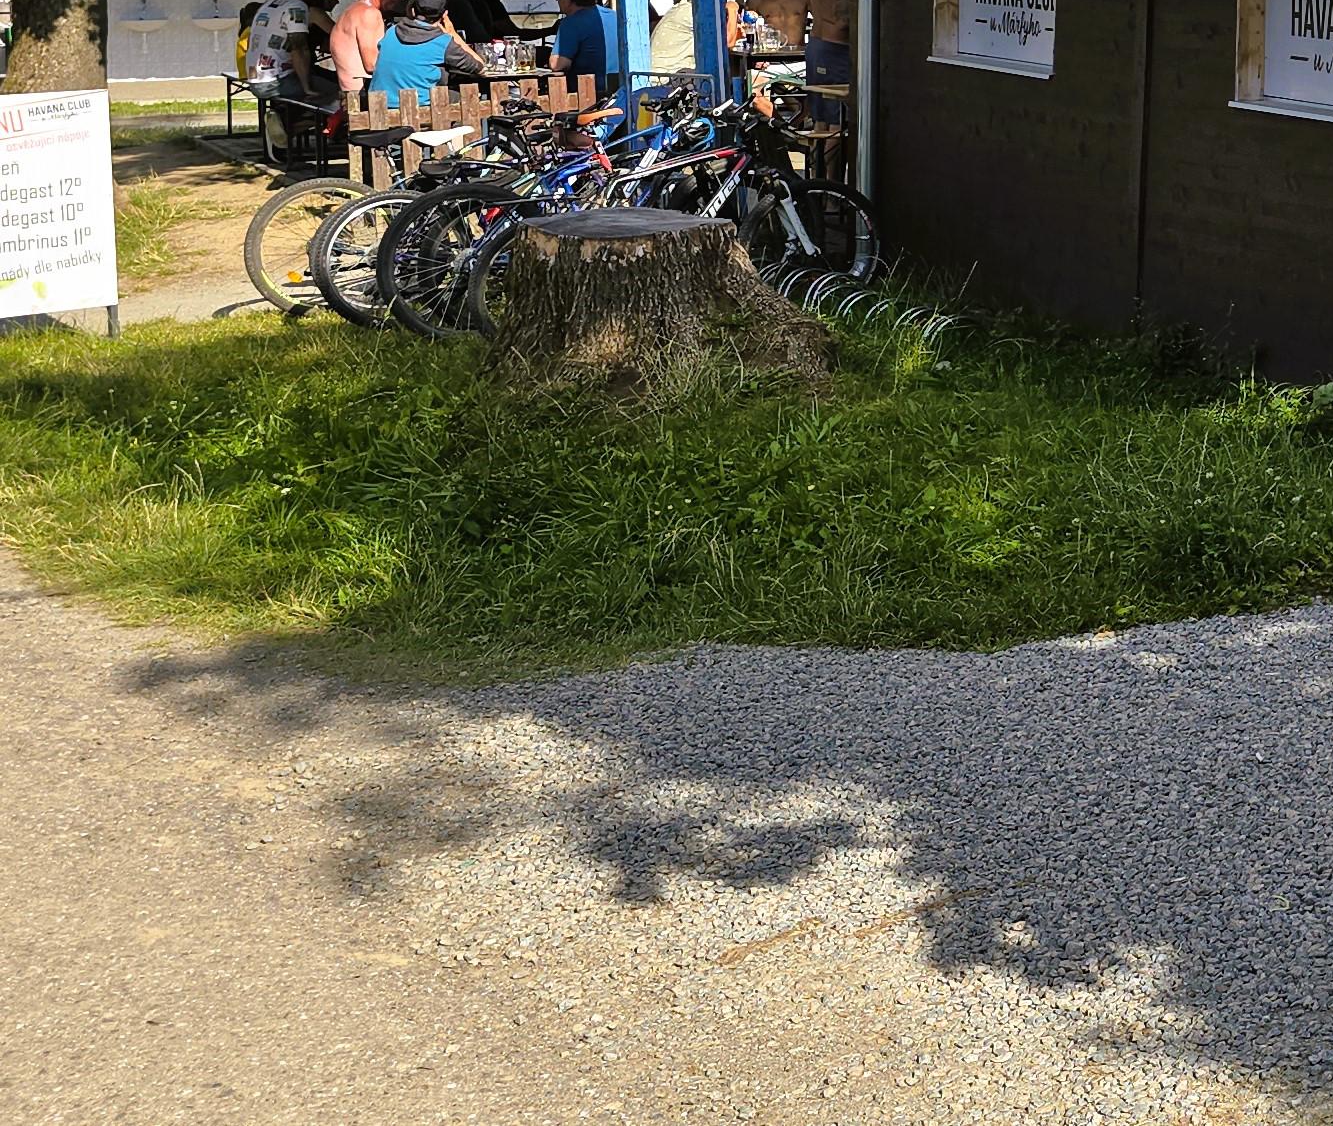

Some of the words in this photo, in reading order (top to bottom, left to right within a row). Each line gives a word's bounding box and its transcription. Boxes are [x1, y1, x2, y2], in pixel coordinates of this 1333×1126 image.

[990, 17, 997, 32] u
[1313, 52, 1324, 72] u
[28, 103, 65, 118] HAVANA
[67, 98, 91, 112] CLUB
[0, 183, 55, 204] degast
[1, 209, 55, 229] degast
[0, 234, 68, 254] mbrinus
[0, 263, 30, 282] nády
[34, 259, 53, 275] dle
